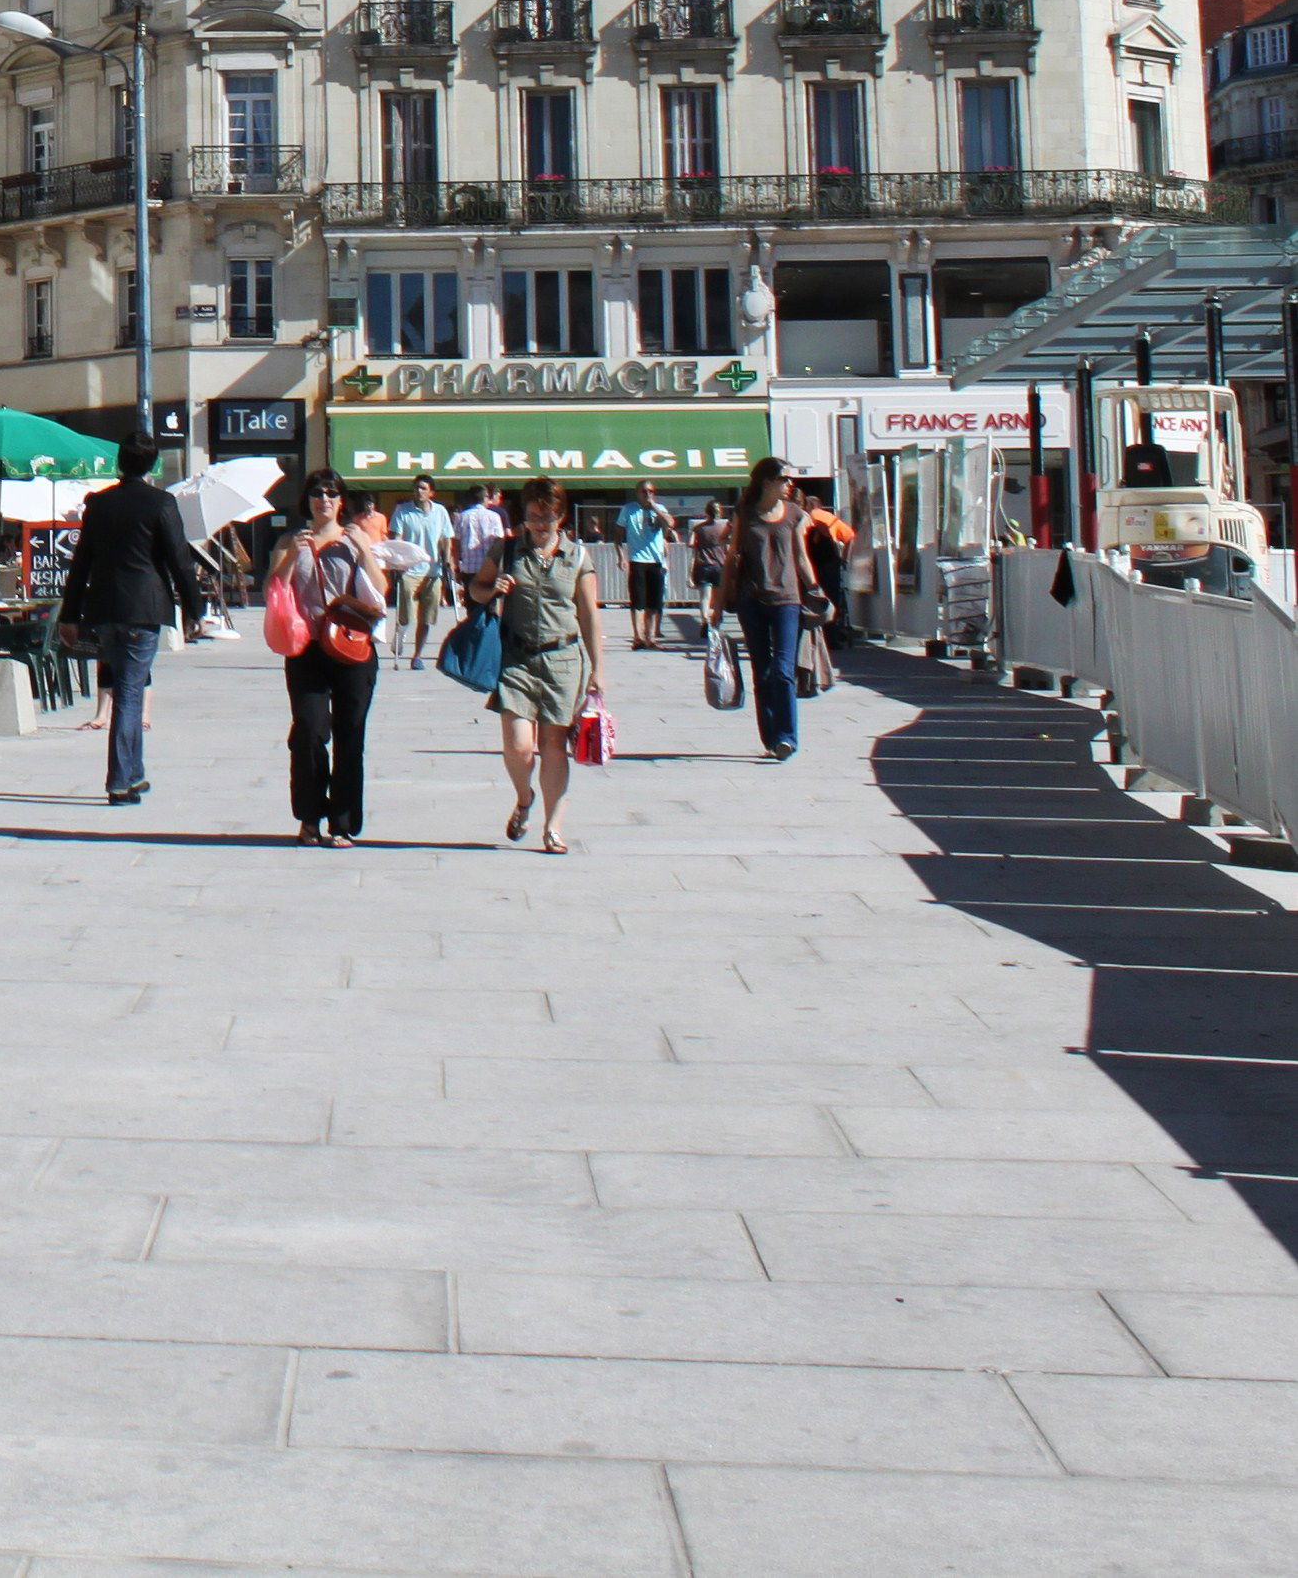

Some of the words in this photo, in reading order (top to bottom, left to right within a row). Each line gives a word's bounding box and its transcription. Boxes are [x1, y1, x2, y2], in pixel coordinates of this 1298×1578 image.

[398, 362, 700, 396] PHARMACIE
[225, 408, 288, 434] iTake
[885, 413, 978, 432] FRANCE
[352, 448, 750, 470] PHARMACIE
[33, 555, 62, 570] BAR
